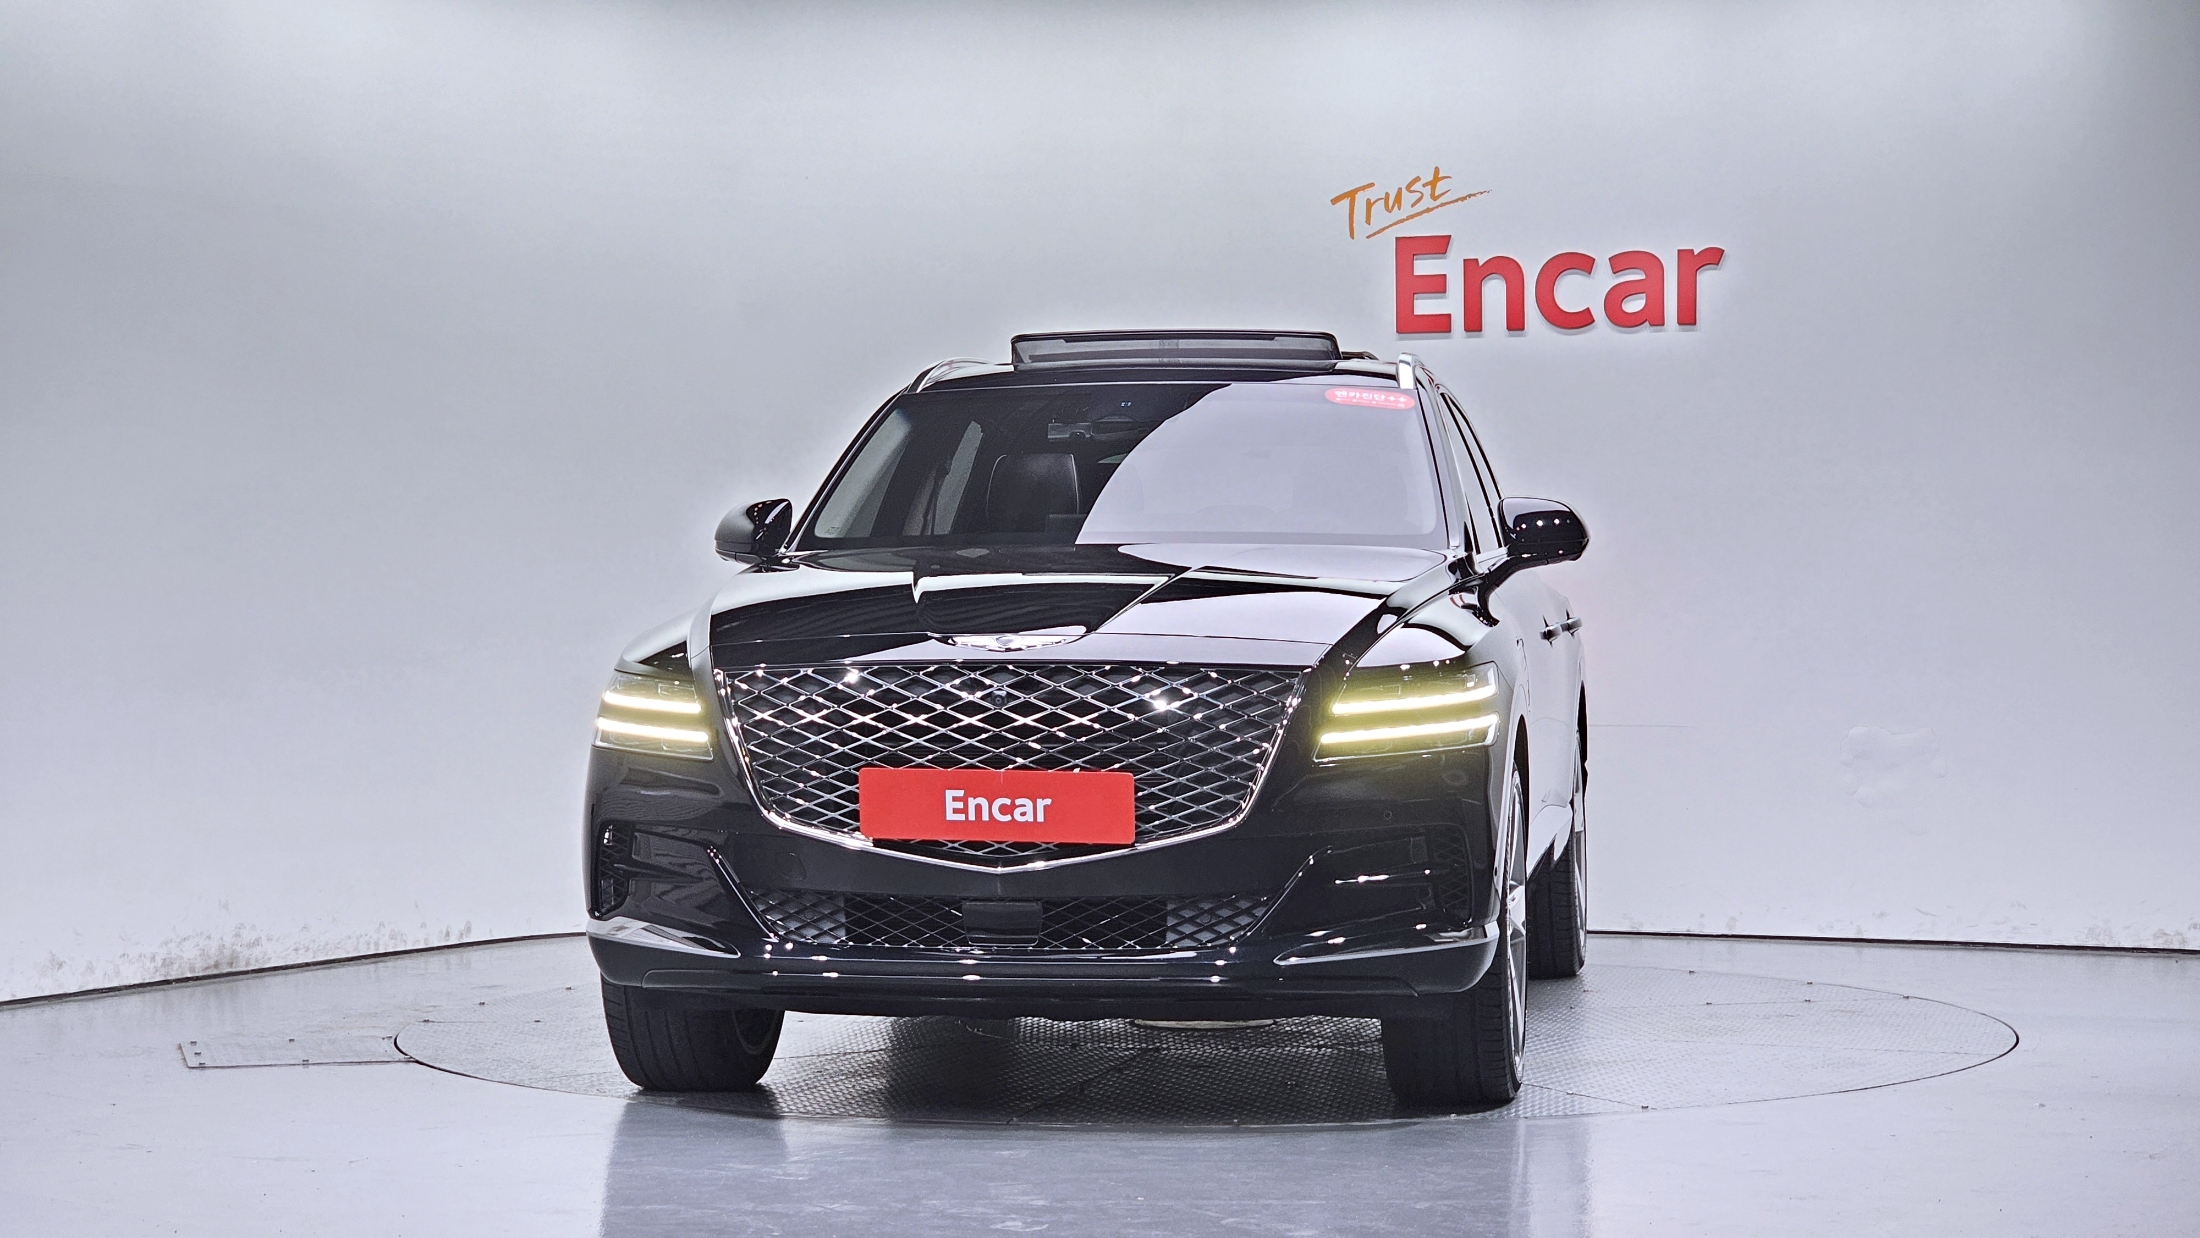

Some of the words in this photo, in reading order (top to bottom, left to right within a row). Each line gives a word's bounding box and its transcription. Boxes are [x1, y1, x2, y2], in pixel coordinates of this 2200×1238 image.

[1331, 166, 1452, 239] Trust
[1395, 235, 1725, 334] Encar
[945, 789, 1052, 822] Encar
